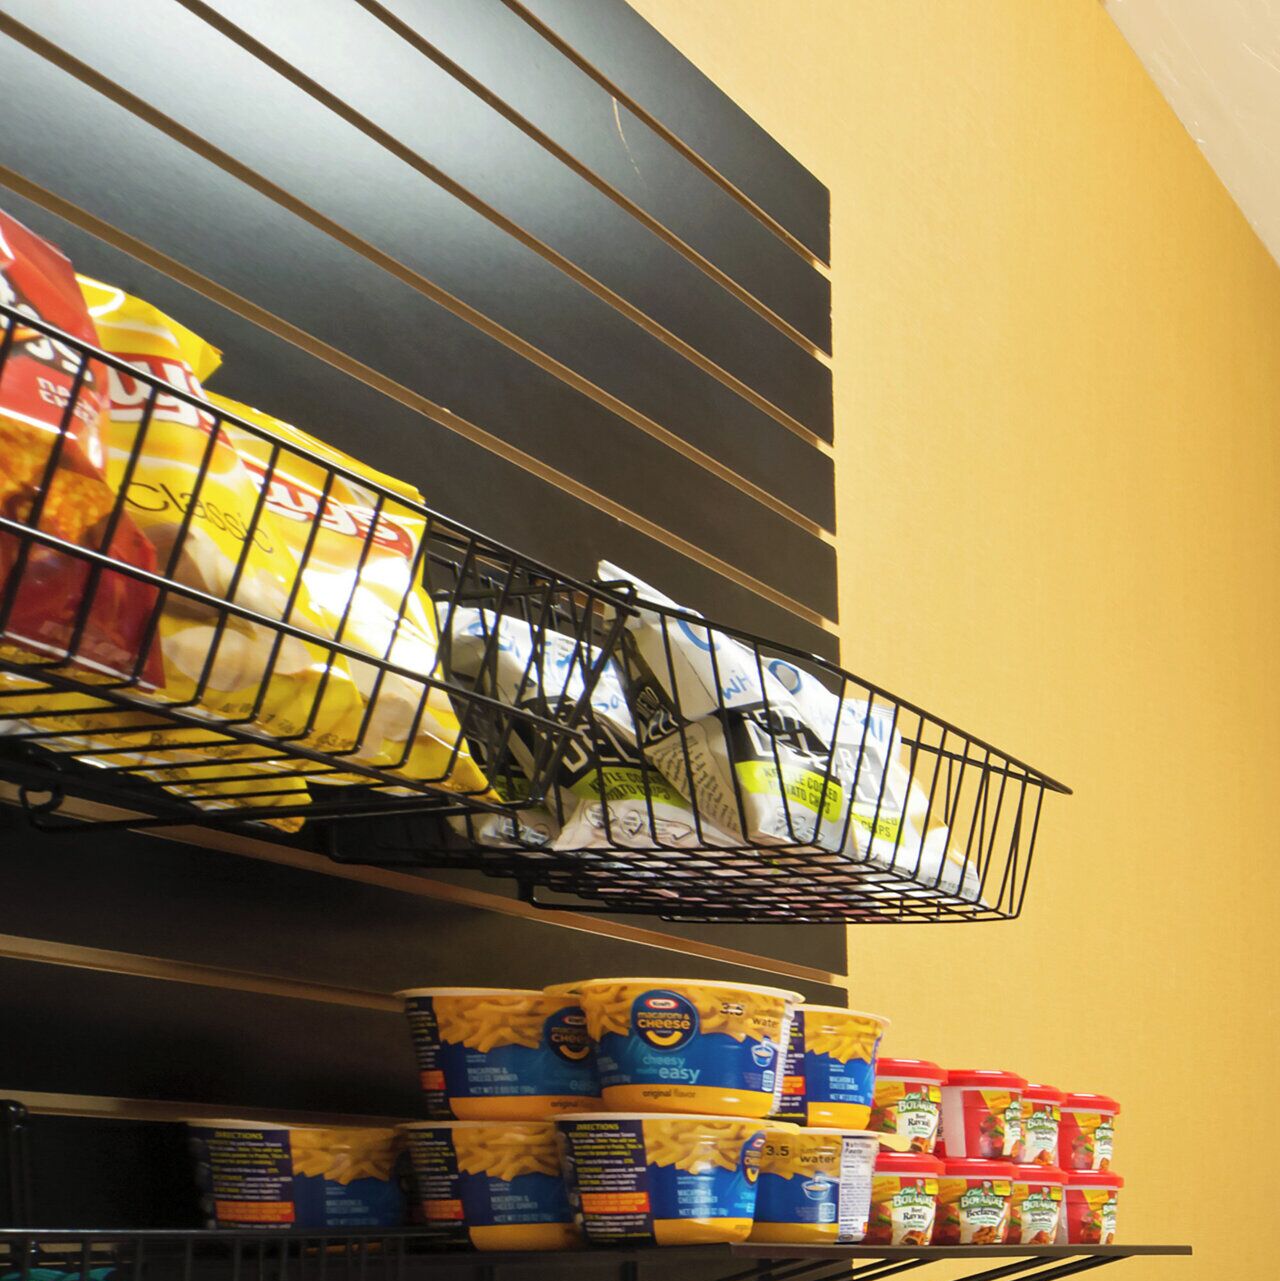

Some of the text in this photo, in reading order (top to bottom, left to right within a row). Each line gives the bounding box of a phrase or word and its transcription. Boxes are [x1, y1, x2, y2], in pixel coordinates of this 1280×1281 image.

[126, 481, 274, 554] Classic
[807, 777, 838, 802] COOED
[809, 792, 830, 815] CHPS
[861, 820, 890, 838] CHPS
[642, 1056, 686, 1068] cheesy
[658, 1066, 701, 1084] easy
[642, 1089, 672, 1100] original
[766, 1145, 790, 1157] 3.5
[800, 1154, 836, 1164] water
